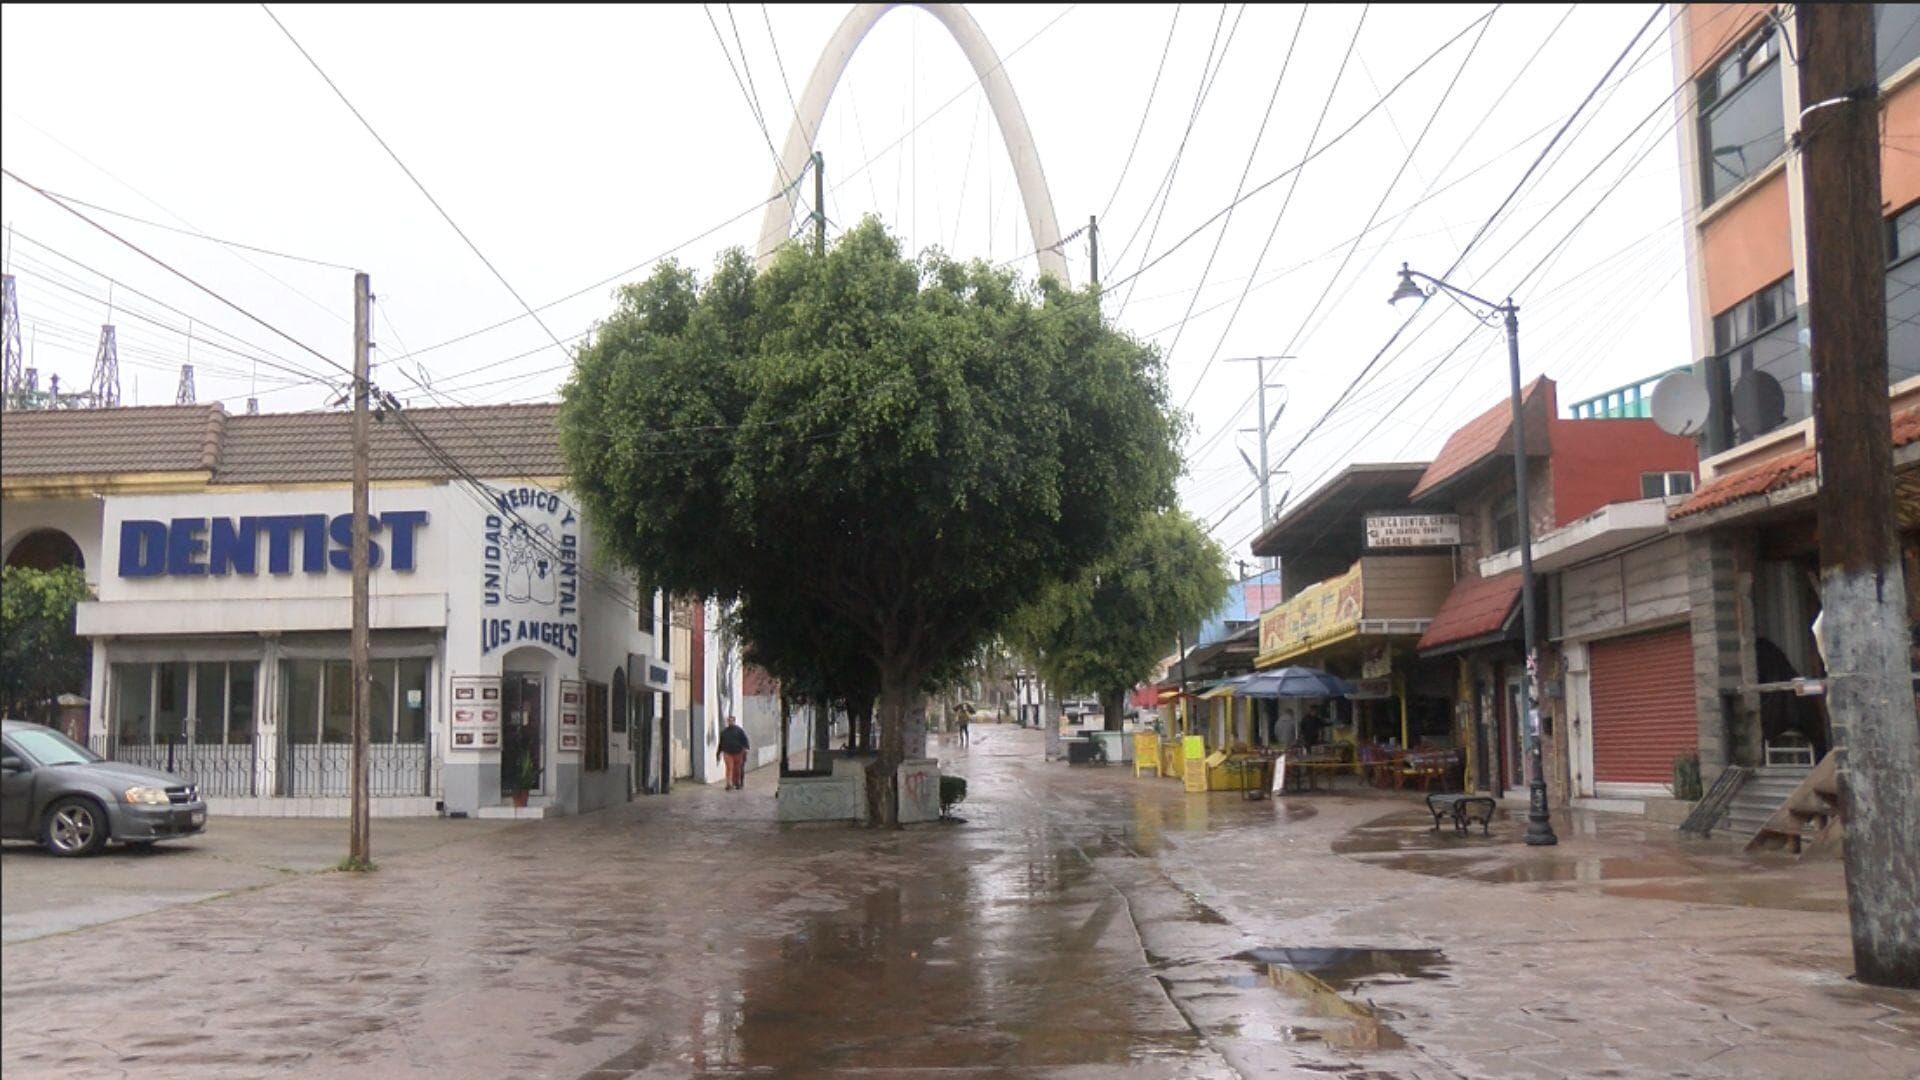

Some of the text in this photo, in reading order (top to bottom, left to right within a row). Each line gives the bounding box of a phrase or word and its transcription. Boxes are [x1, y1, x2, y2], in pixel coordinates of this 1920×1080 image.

[118, 511, 430, 577] DENTIST
[485, 487, 577, 616] UNIDAD MEDICO Y DENTAL
[481, 618, 578, 657] LOS ANGEL'S
